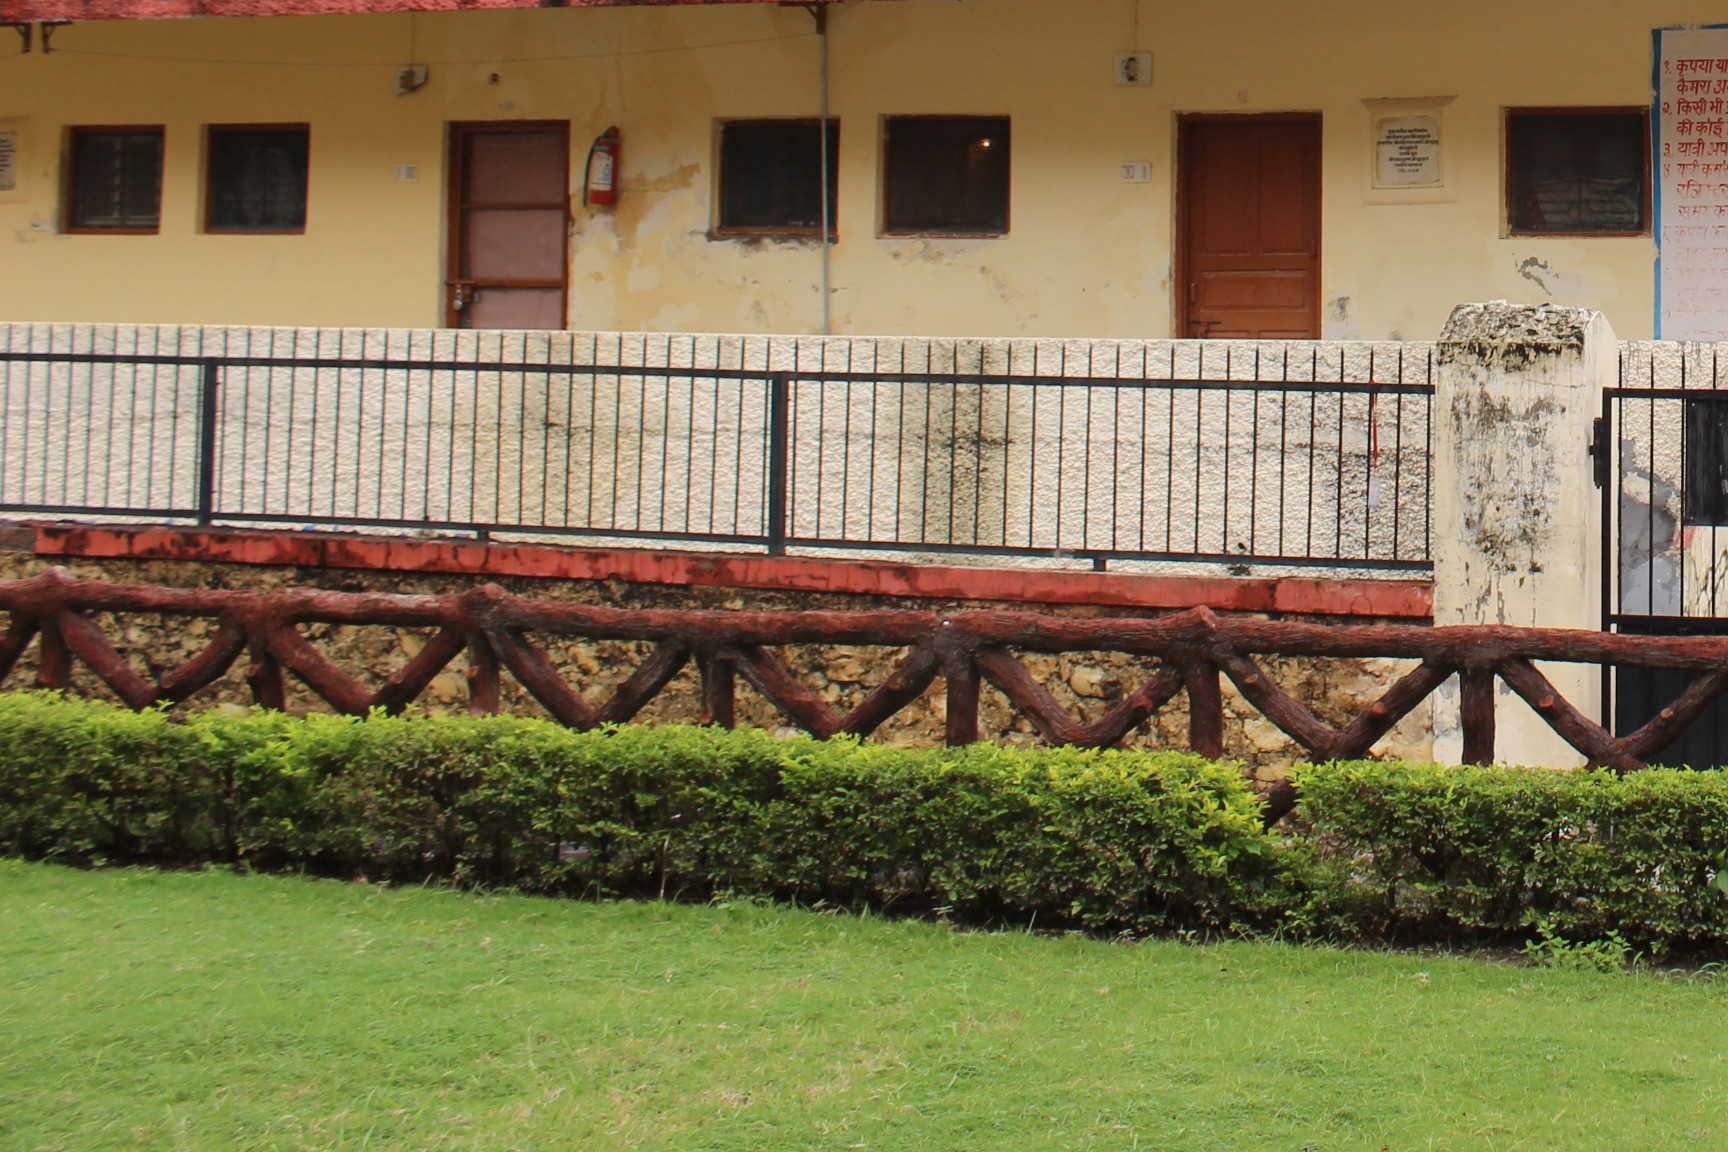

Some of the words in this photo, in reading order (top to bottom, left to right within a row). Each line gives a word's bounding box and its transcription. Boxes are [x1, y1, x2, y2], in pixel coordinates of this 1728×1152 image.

[1677, 58, 1714, 77] कृपया
[1677, 78, 1712, 95] कैमरा
[1676, 97, 1708, 115] किसी
[1710, 96, 1724, 115] भी
[1677, 118, 1694, 137] की
[1695, 117, 1724, 138] कोई
[1677, 137, 1705, 157] यात्री
